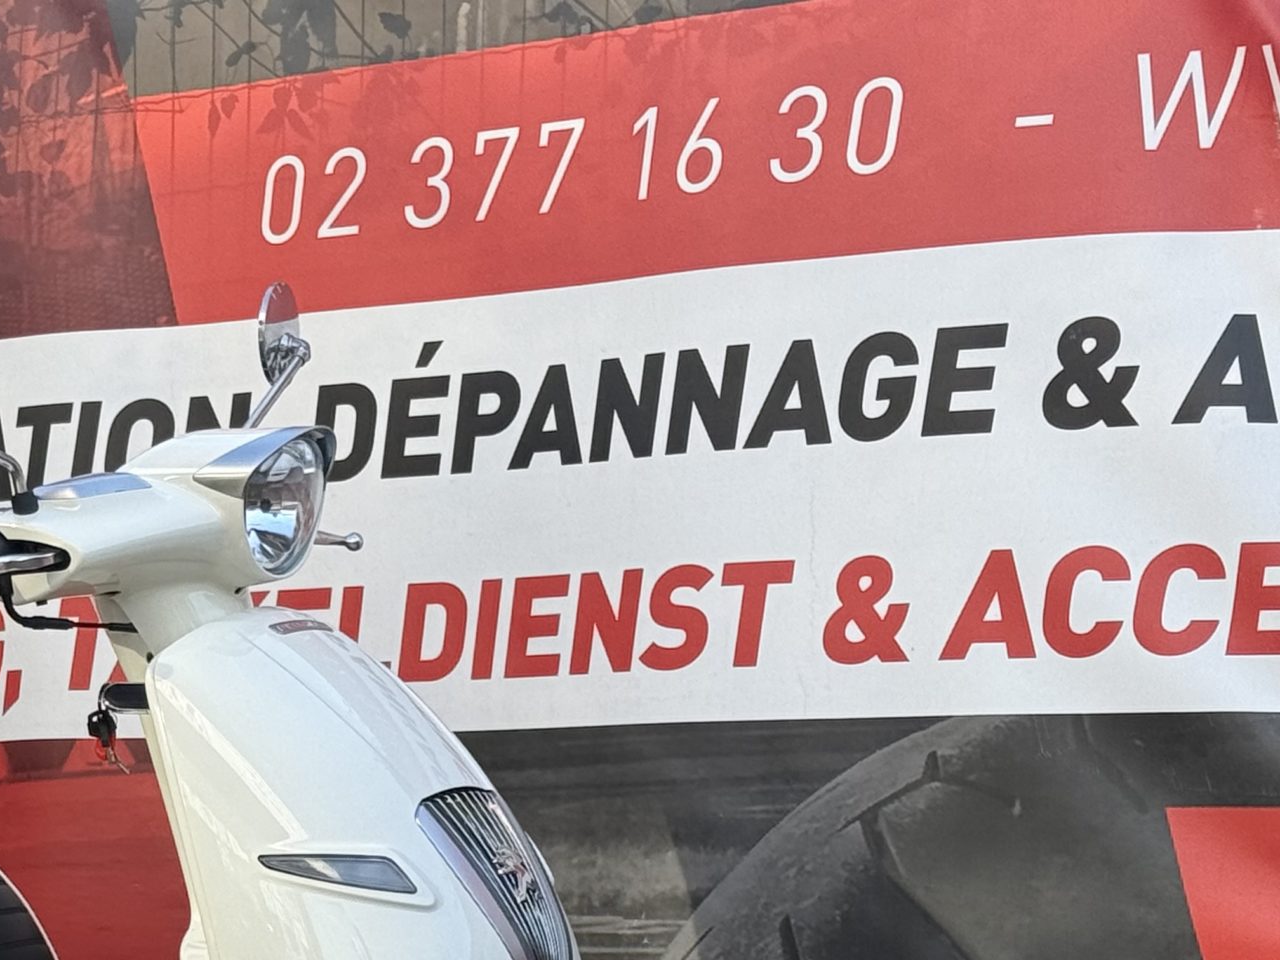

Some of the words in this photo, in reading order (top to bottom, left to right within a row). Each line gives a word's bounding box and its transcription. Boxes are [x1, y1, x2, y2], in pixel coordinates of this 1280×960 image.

[260, 146, 368, 245] 02
[403, 117, 586, 229] 377
[631, 97, 724, 201] 16
[768, 76, 905, 183] 30
[1013, 113, 1055, 128] -
[1136, 43, 1280, 151] W
[314, 322, 1009, 480] DÉPANNAGE
[1041, 315, 1140, 430] &
[823, 555, 908, 664] &
[940, 542, 1280, 660] ACCE
